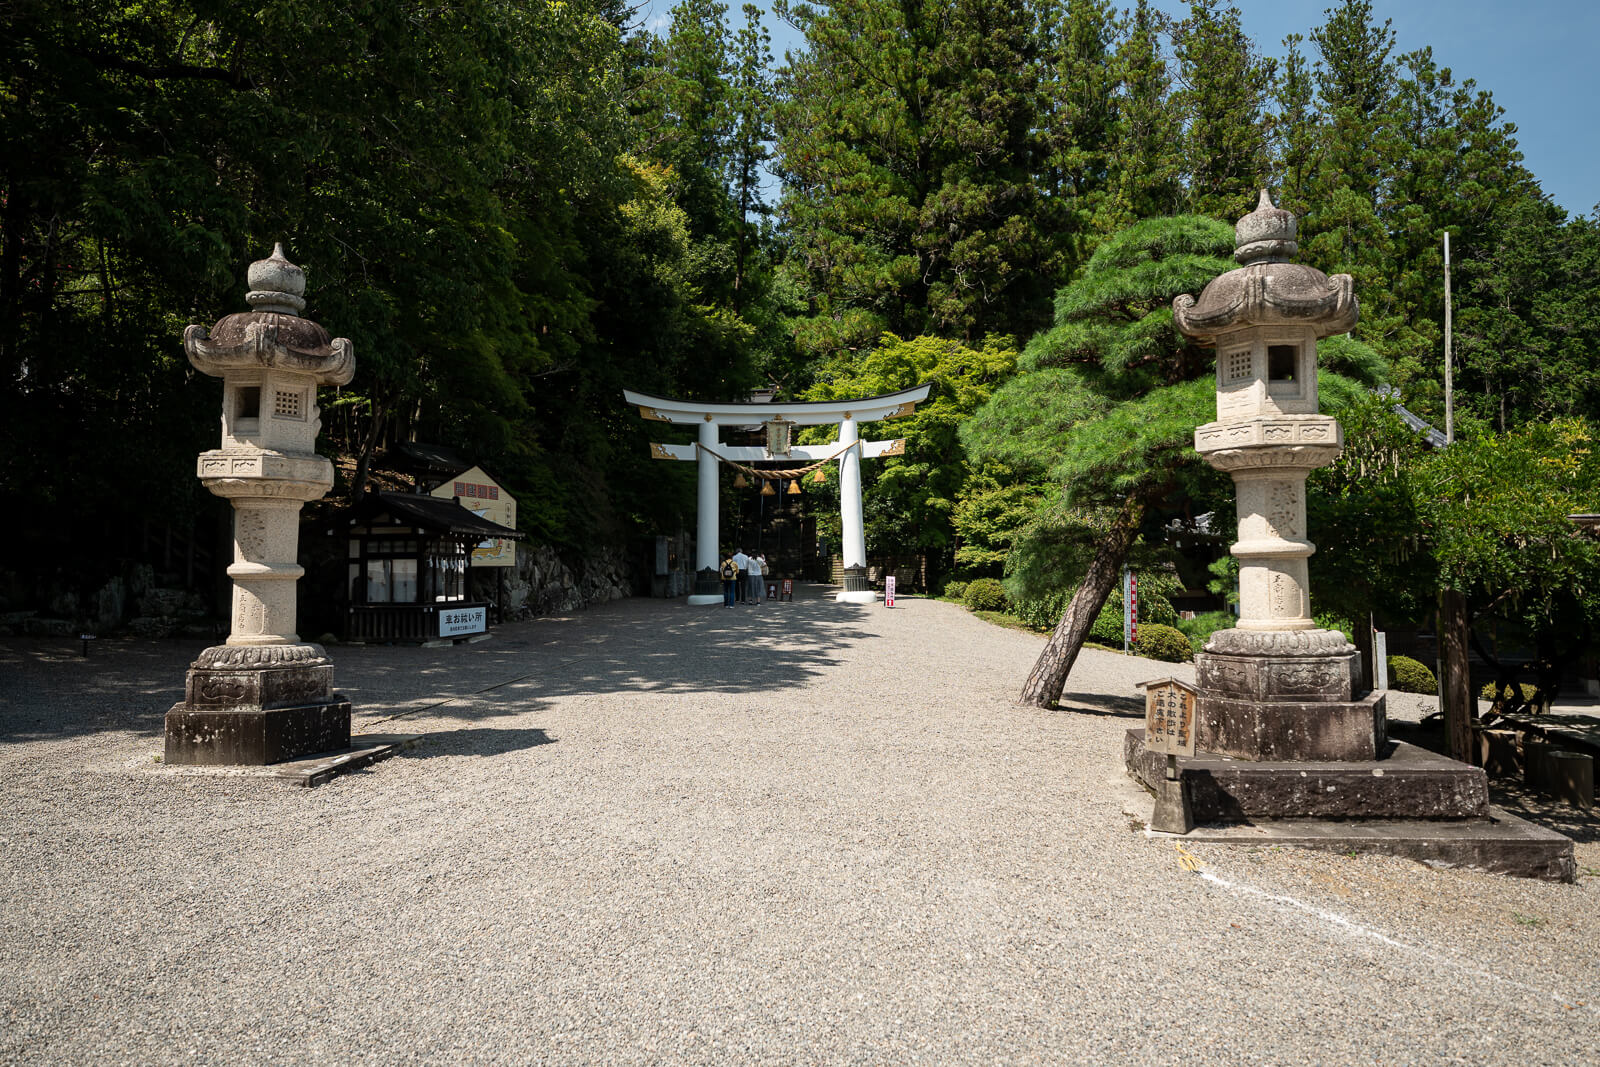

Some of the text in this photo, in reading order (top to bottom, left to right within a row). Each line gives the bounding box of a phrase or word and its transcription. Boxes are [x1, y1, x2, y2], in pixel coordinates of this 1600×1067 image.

[445, 611, 483, 624] 車お祓い所
[1155, 690, 1166, 743] ご遠慮下さい
[1166, 691, 1177, 736] 犬の散歩は
[1177, 693, 1187, 747] これより聖域
